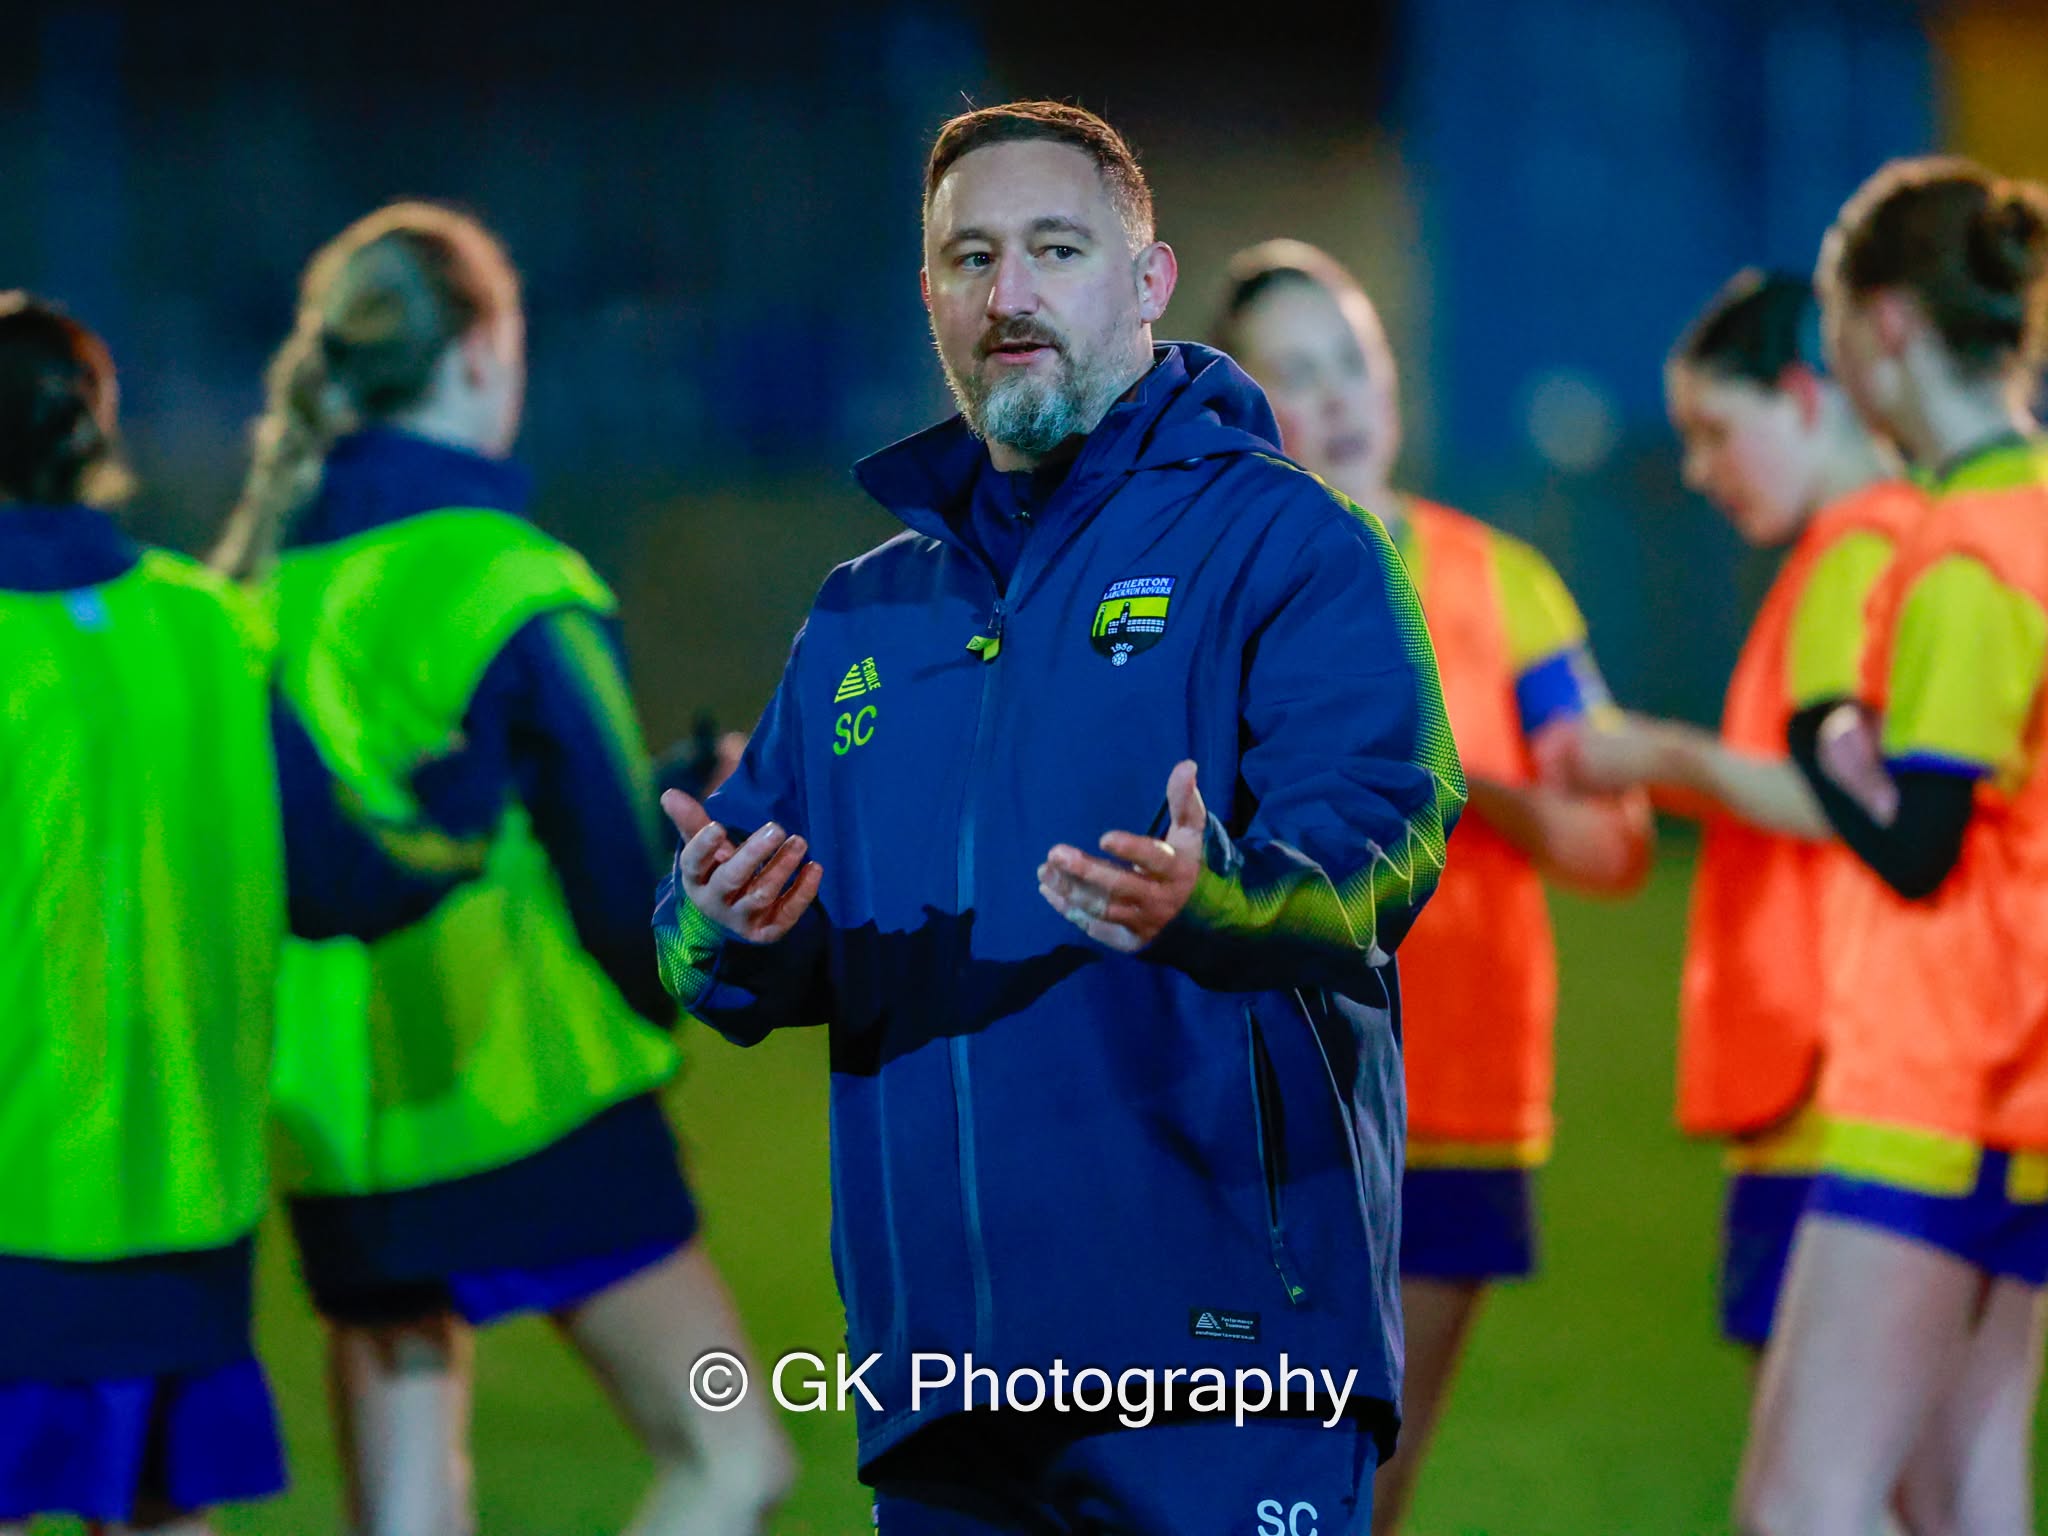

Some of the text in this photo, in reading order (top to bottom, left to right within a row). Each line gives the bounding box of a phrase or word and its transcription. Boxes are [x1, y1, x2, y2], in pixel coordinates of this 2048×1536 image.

[1109, 578, 1169, 592] ATHERTON
[1140, 586, 1172, 595] ROVERS
[1110, 642, 1134, 653] 1956
[861, 656, 882, 691] PENDLE
[833, 705, 877, 755] SC
[1256, 1499, 1318, 1536] SC
